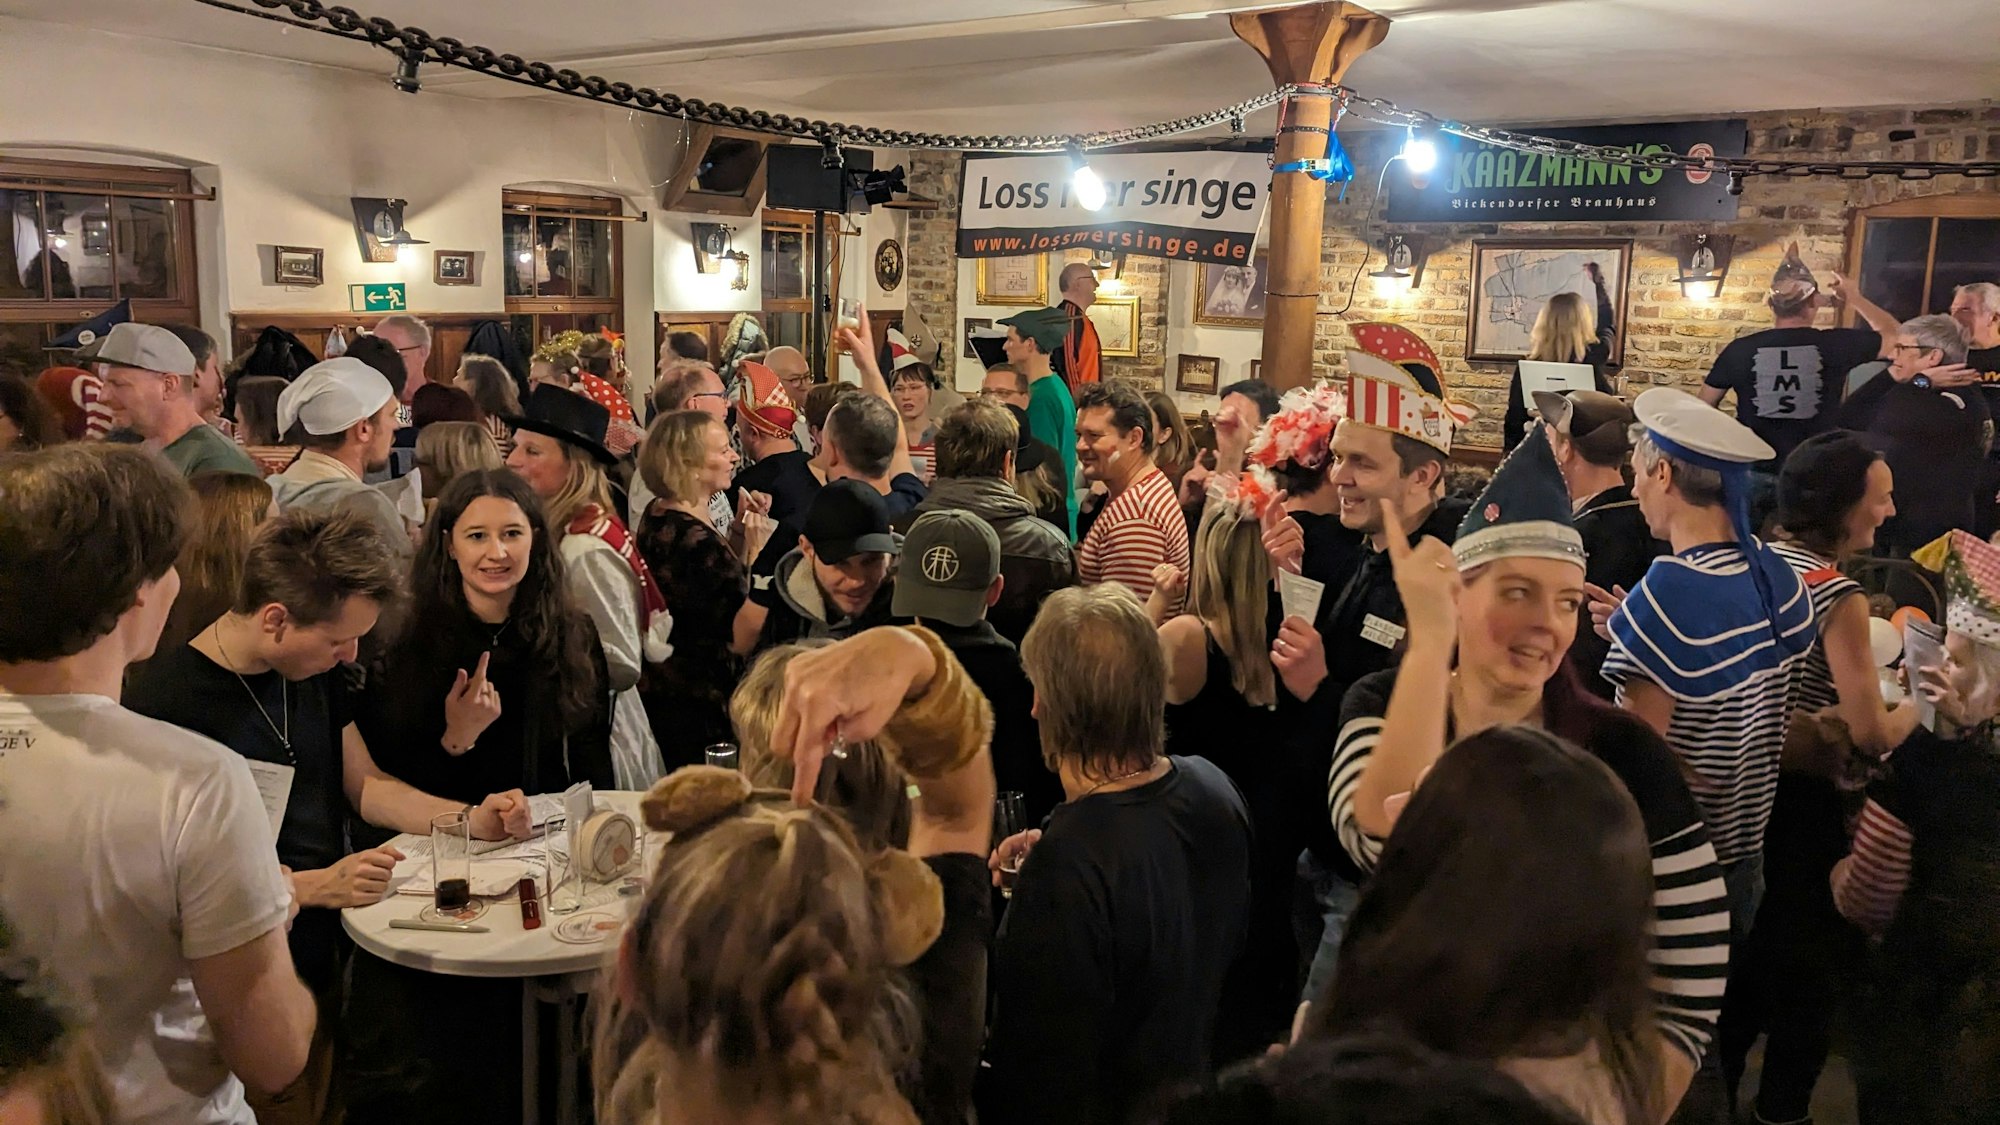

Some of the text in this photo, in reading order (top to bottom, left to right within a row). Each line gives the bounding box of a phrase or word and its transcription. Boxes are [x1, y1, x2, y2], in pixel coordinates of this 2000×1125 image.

[979, 176, 1049, 209] Loss
[1142, 169, 1256, 219] singe
[1451, 195, 1658, 211] Bickendorfer Brauhaus
[973, 230, 1246, 260] www.lossmersinge.de
